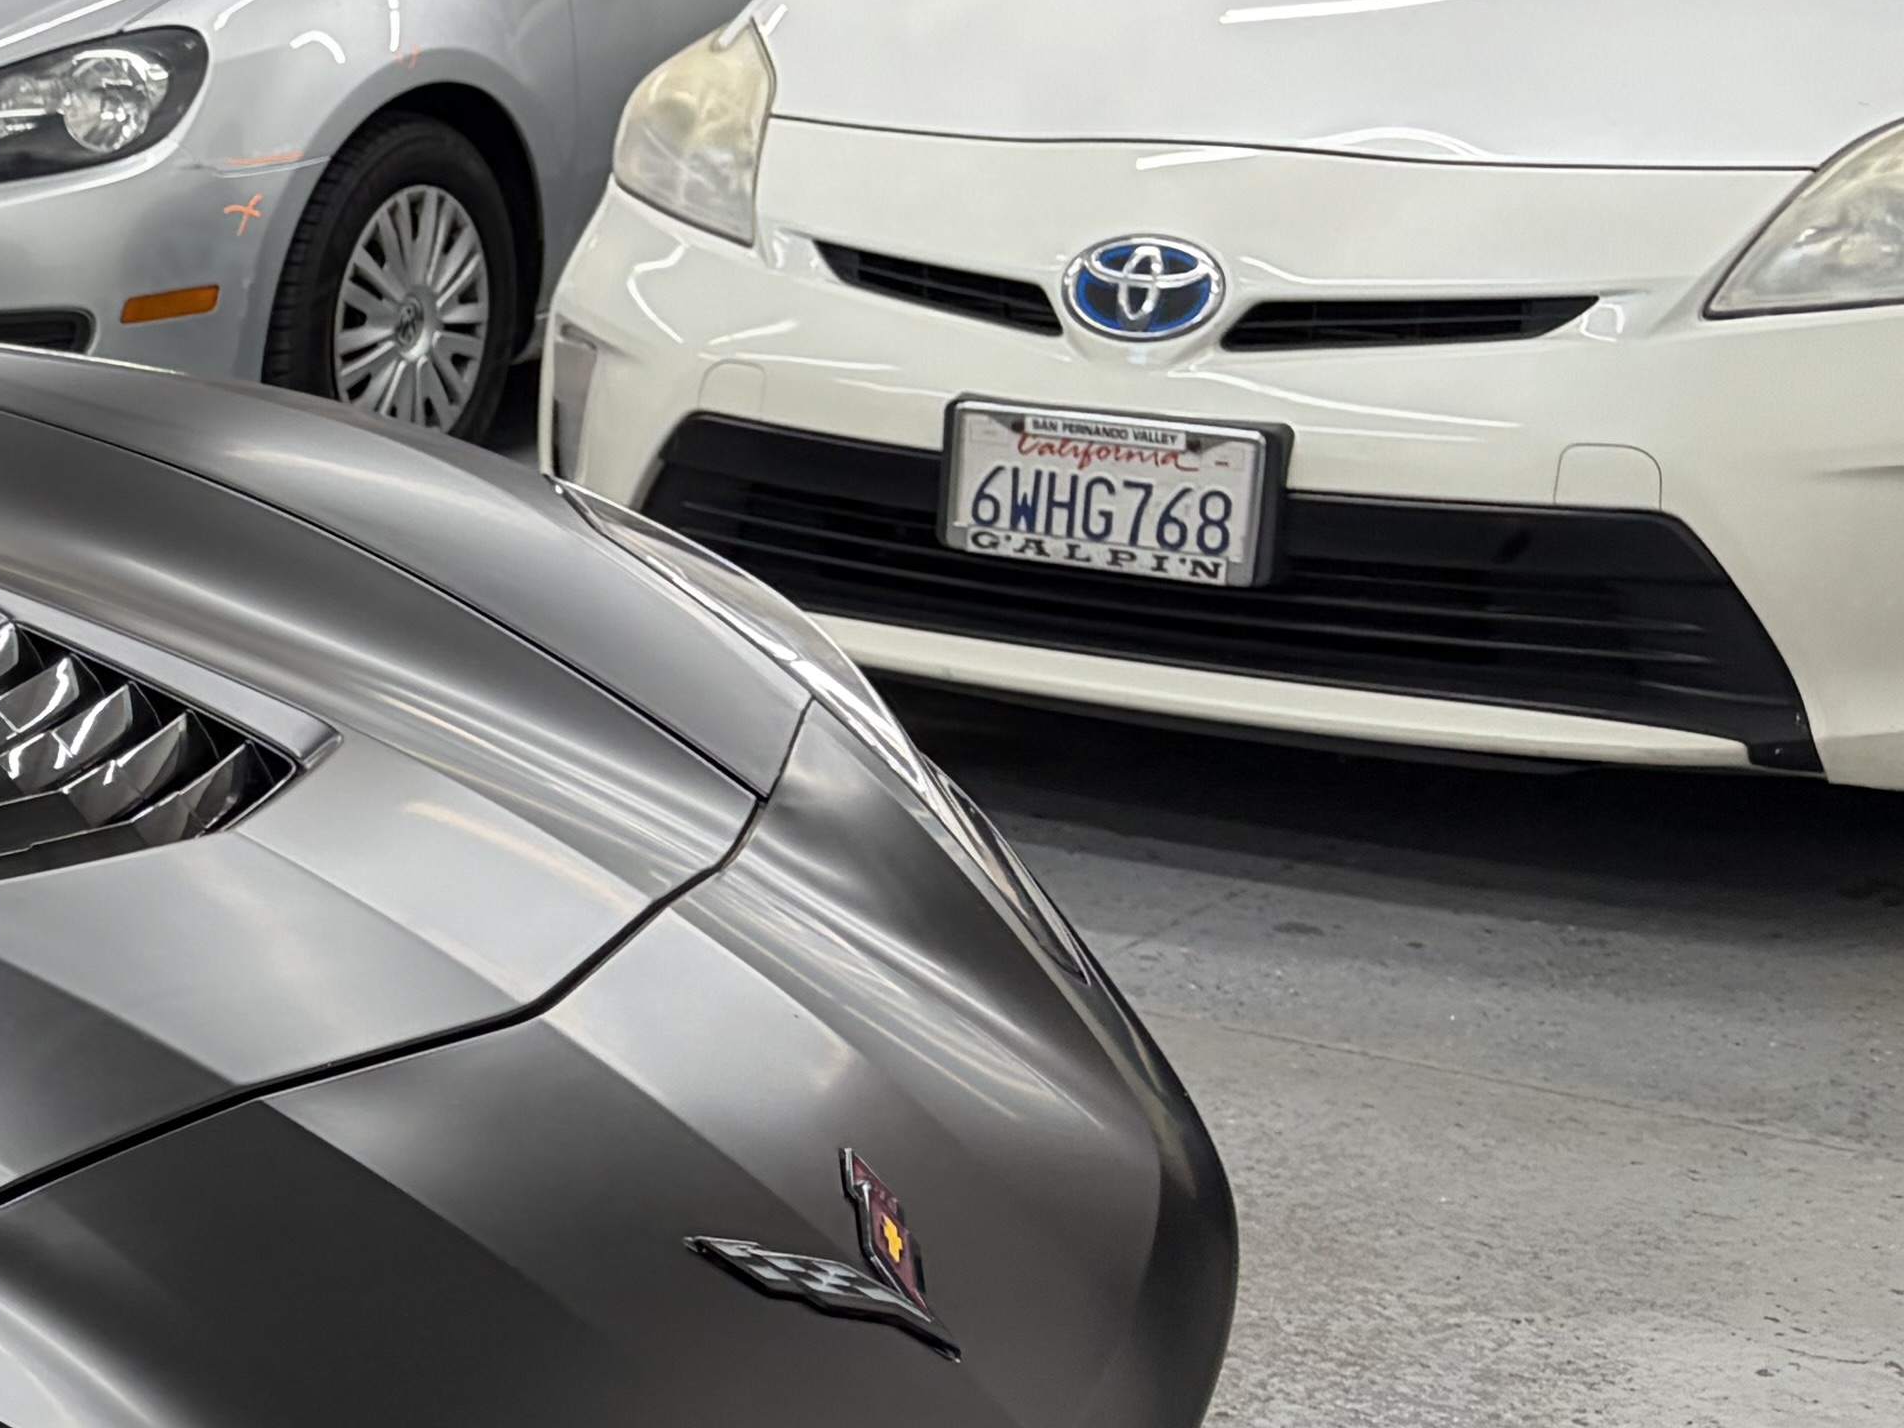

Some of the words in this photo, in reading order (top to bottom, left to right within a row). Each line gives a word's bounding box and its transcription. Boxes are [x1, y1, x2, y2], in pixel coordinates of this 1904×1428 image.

[1017, 431, 1199, 471] California
[1032, 419, 1058, 433] SAN
[1062, 422, 1128, 441] FERNANDO
[1133, 430, 1178, 447] VALLEY
[971, 465, 1233, 556] 6WHG768
